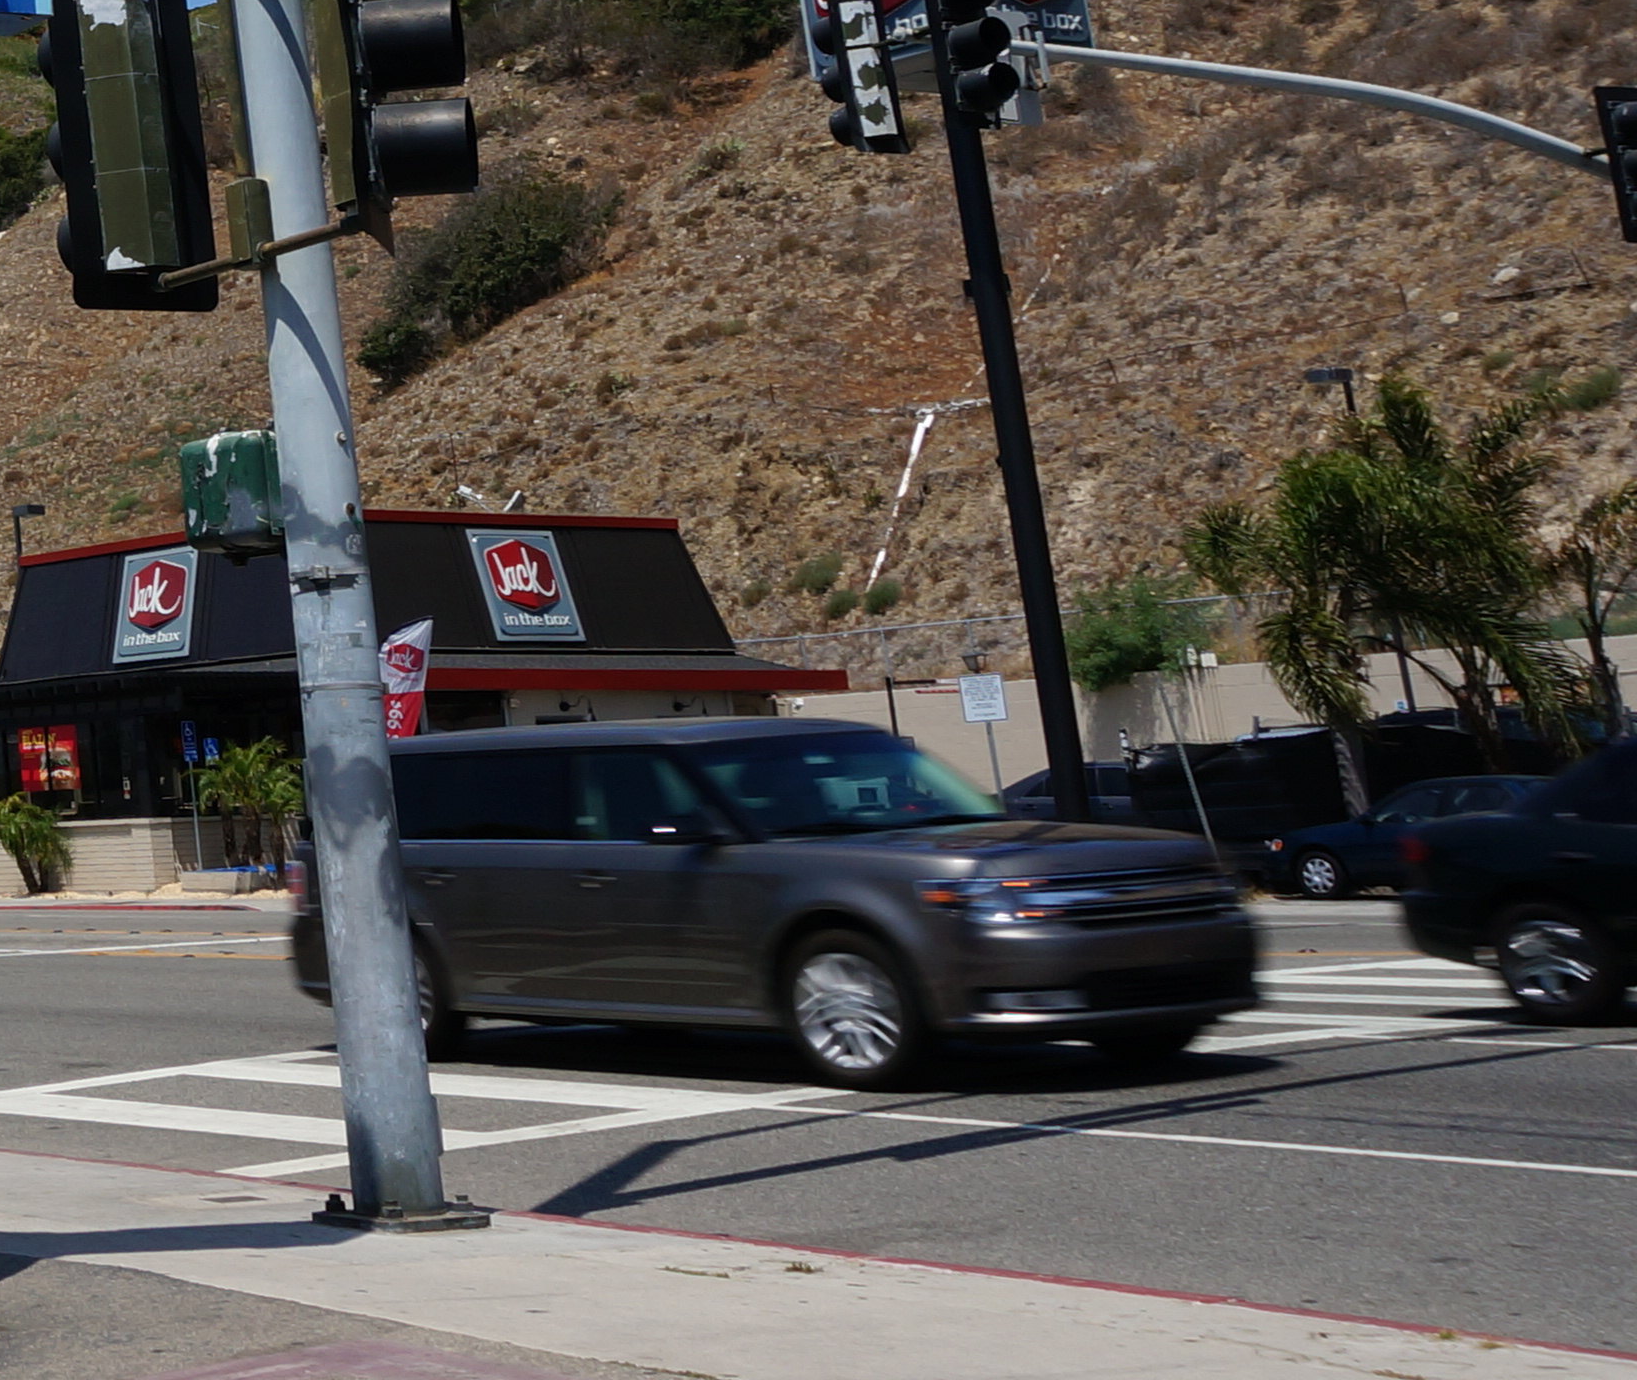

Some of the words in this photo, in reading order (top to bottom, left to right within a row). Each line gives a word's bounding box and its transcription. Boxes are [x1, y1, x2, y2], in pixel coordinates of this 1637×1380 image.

[1042, 8, 1083, 30] box
[492, 546, 556, 597] Jack
[128, 566, 182, 618] Jack
[503, 612, 519, 626] in
[519, 613, 544, 626] the
[544, 613, 572, 626] box
[135, 632, 157, 645] the
[157, 630, 182, 643] box
[389, 645, 420, 670] Jack
